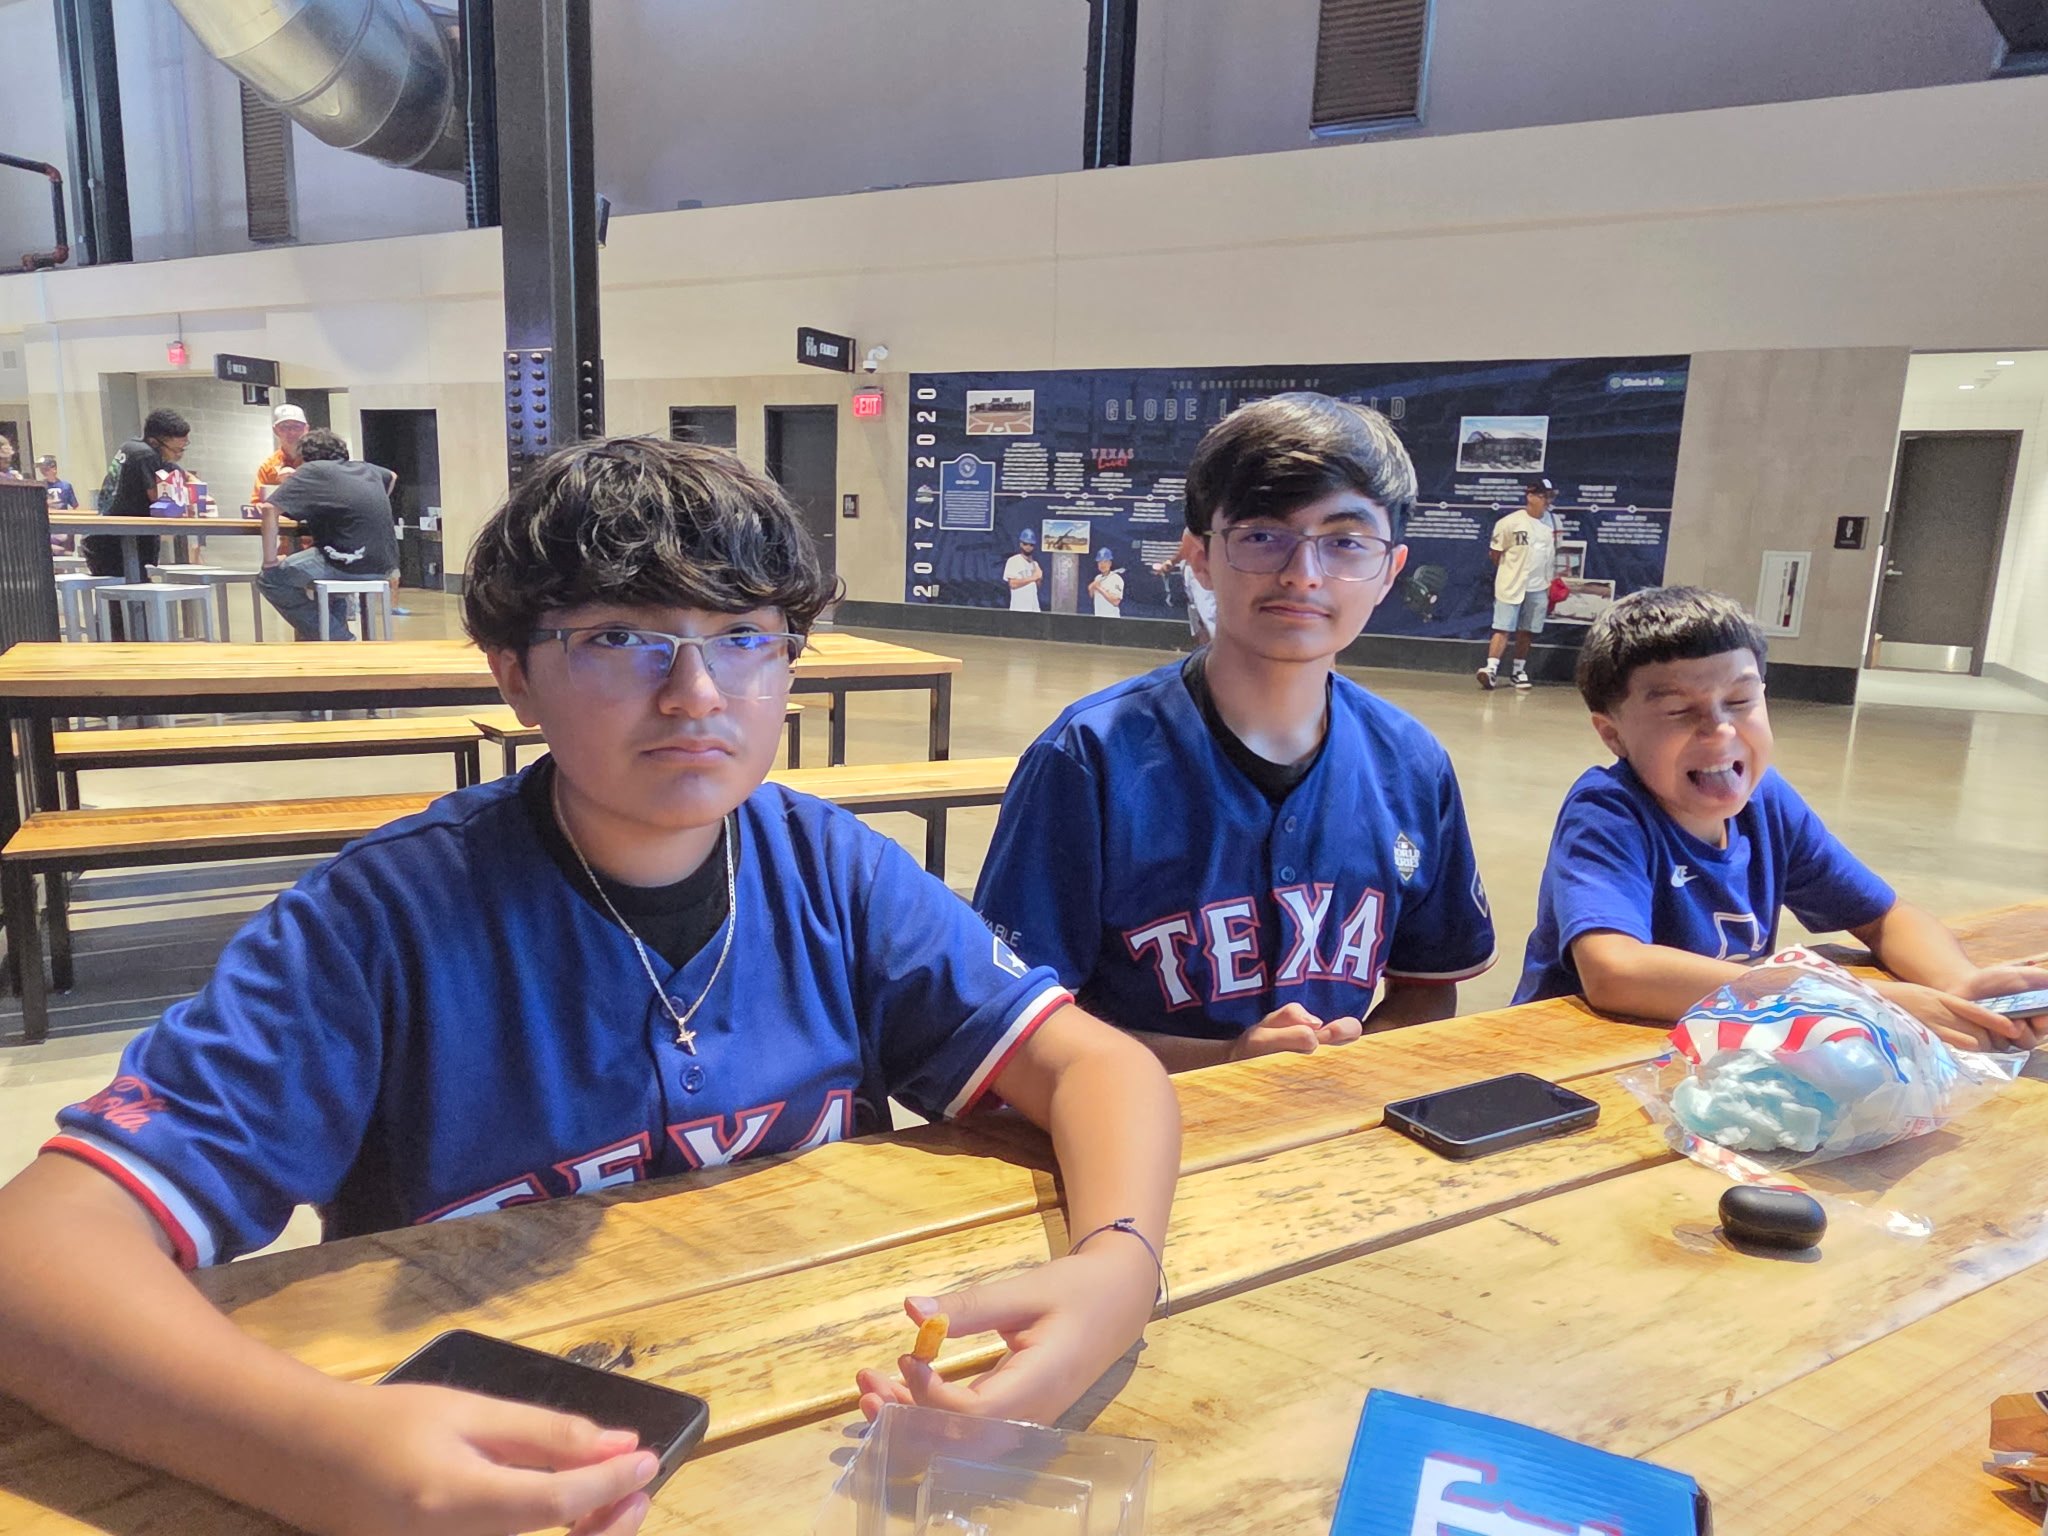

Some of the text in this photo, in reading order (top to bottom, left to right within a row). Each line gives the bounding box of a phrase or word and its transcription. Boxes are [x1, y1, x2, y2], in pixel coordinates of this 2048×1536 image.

[859, 397, 879, 415] EXIT
[1105, 398, 1198, 421] GLOBE
[912, 387, 937, 598] 2017 2020
[1122, 883, 1387, 1012] TEXA
